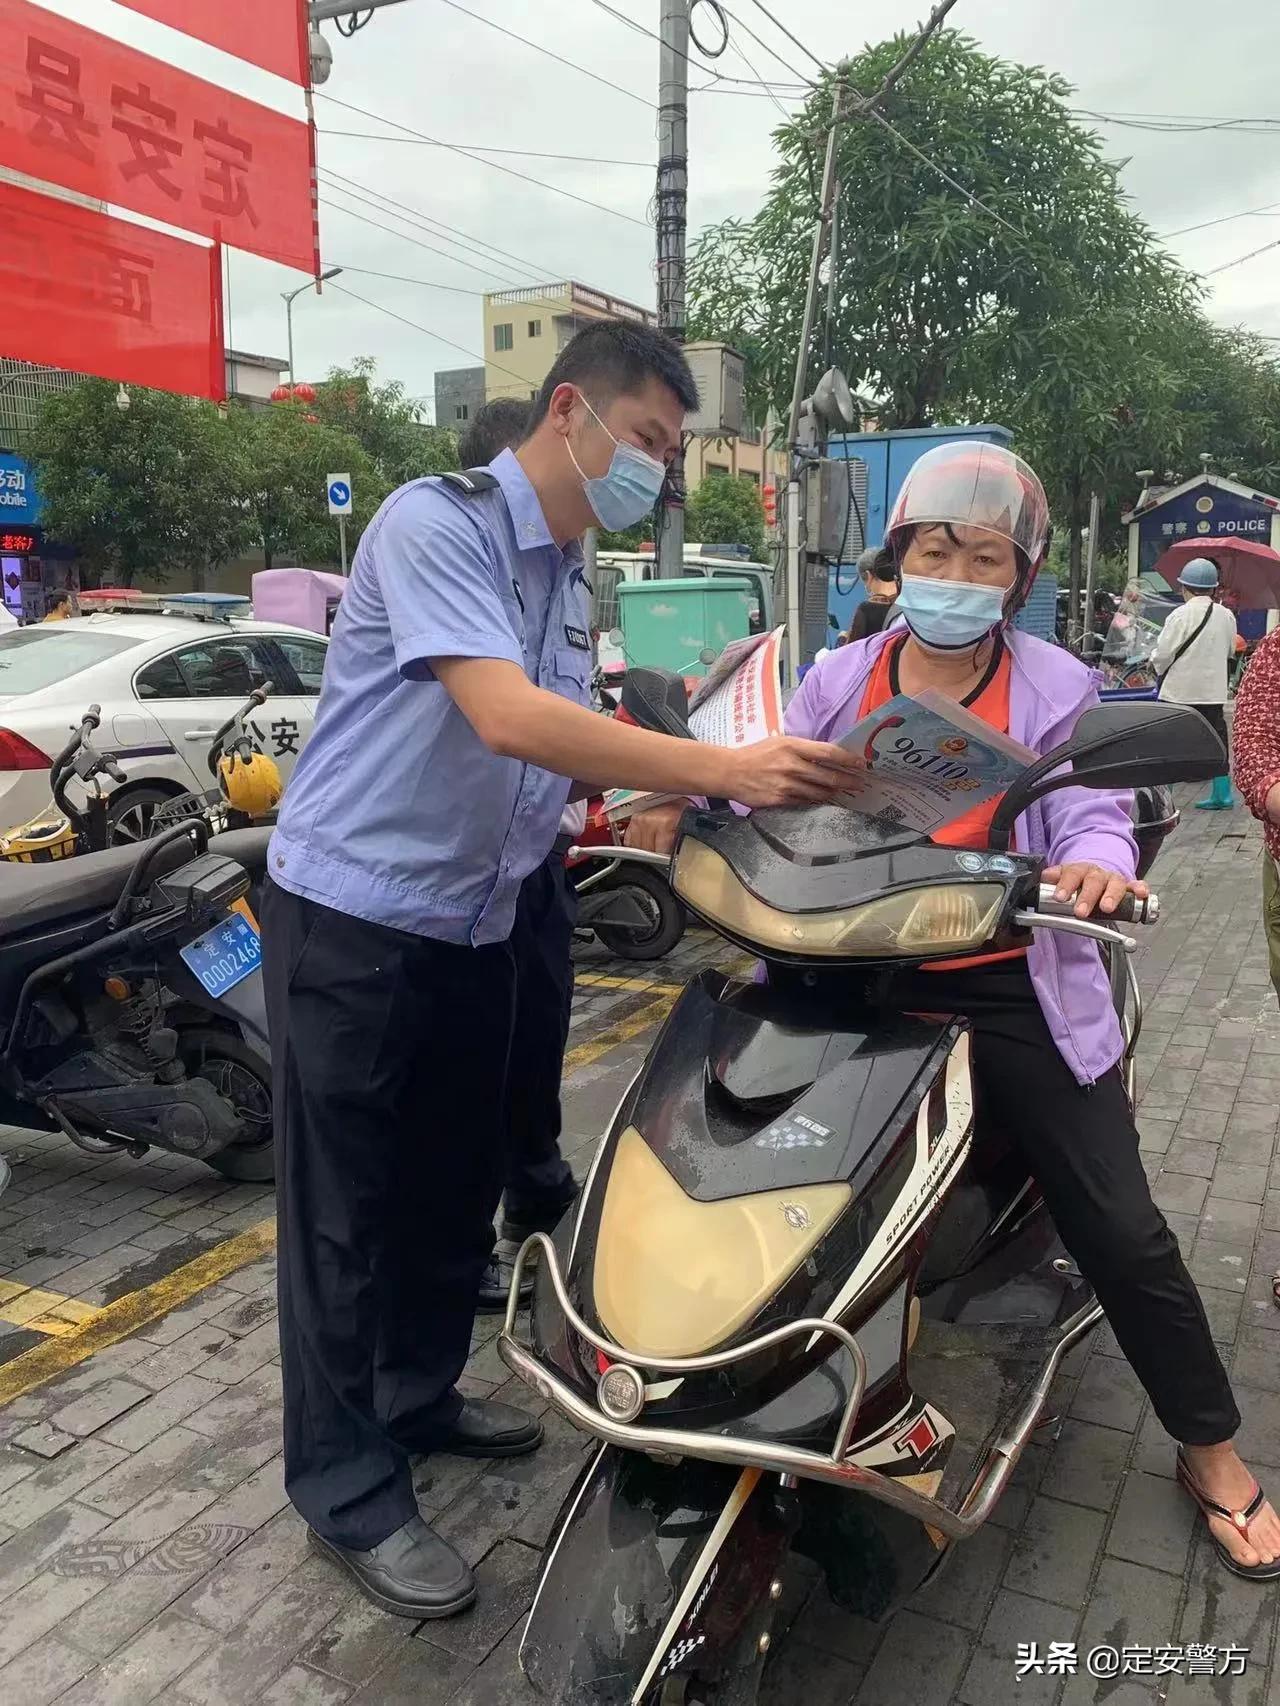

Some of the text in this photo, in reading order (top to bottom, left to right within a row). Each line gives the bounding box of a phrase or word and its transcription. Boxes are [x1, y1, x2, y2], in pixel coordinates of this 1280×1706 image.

[0, 492, 27, 507] obile
[1162, 522, 1187, 535] 警察
[1218, 519, 1266, 532] POLICE
[887, 737, 969, 780] 96110
[201, 930, 236, 959] 定安
[886, 1145, 951, 1245] SPORT POWER
